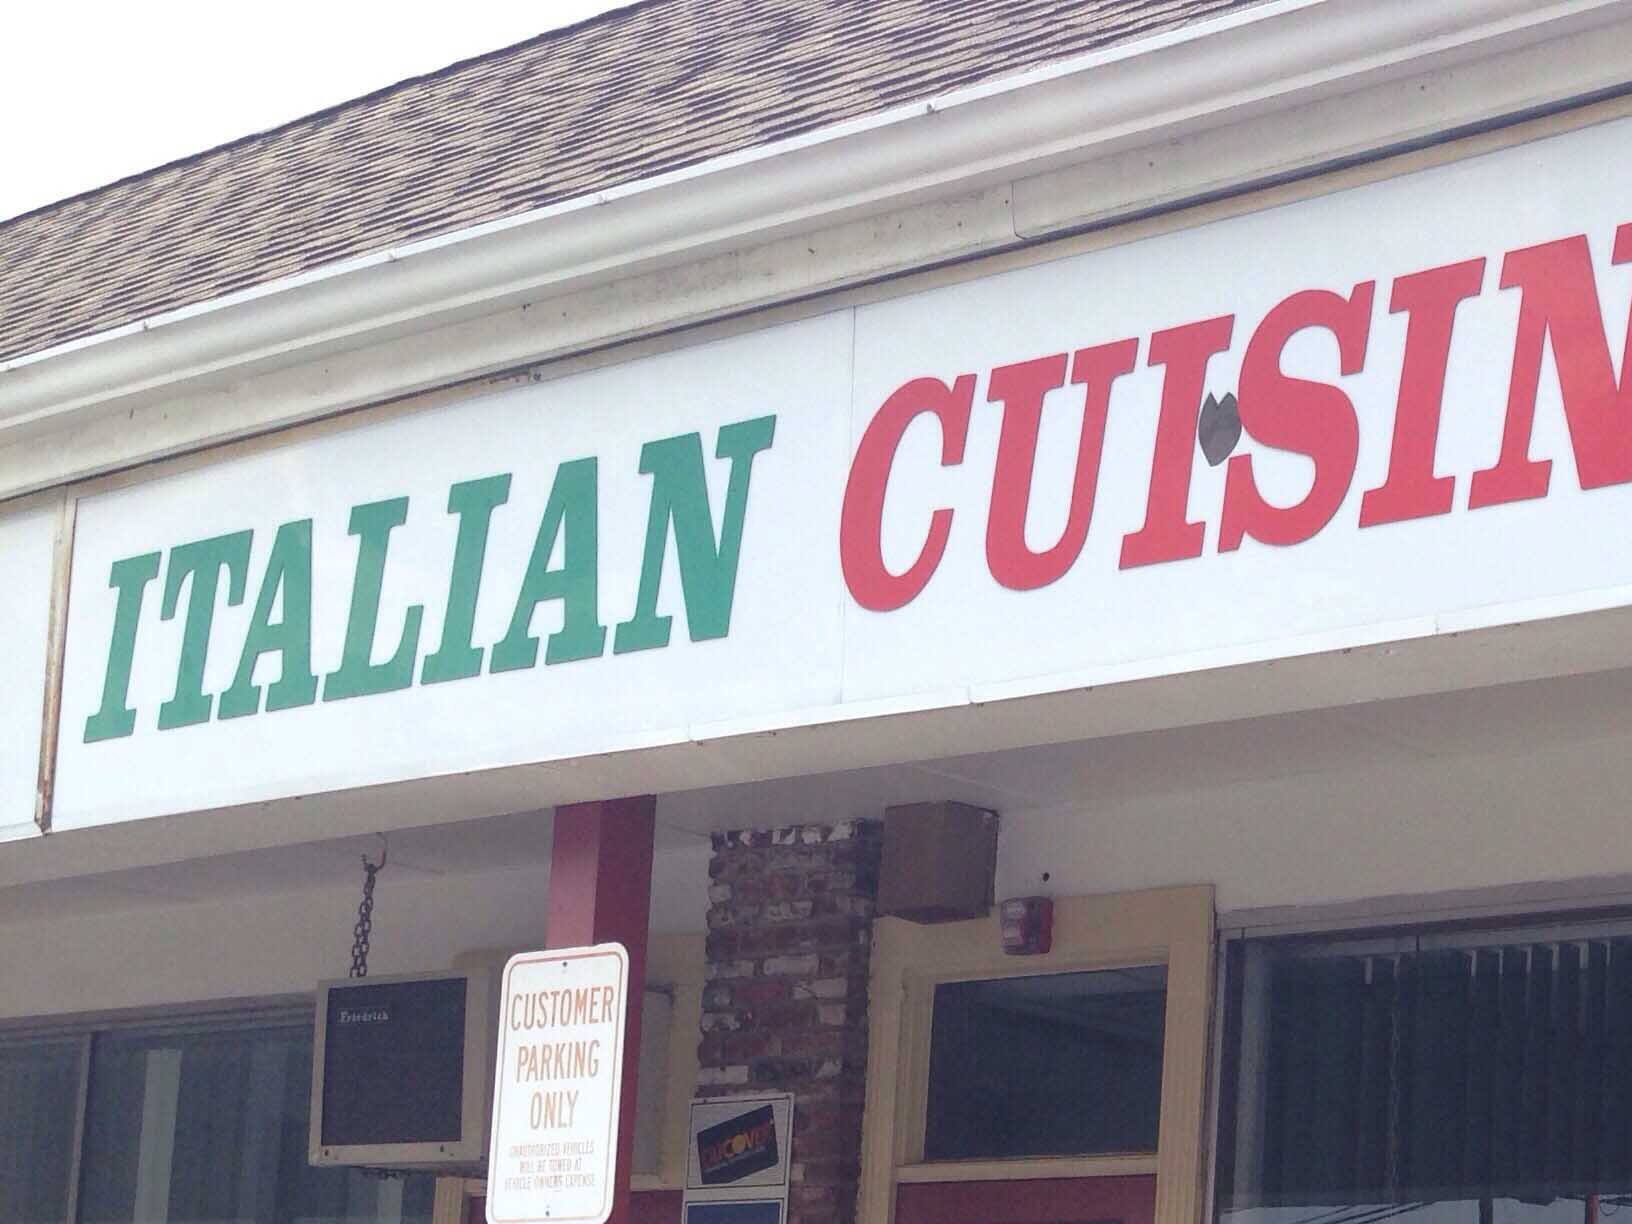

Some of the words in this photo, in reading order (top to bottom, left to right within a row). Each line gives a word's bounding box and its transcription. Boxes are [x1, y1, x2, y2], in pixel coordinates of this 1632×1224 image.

[83, 414, 777, 743] ITALIAN
[511, 986, 615, 1031] CUSTOMER
[516, 1040, 600, 1083] PARKING
[530, 1090, 579, 1130] ONLY
